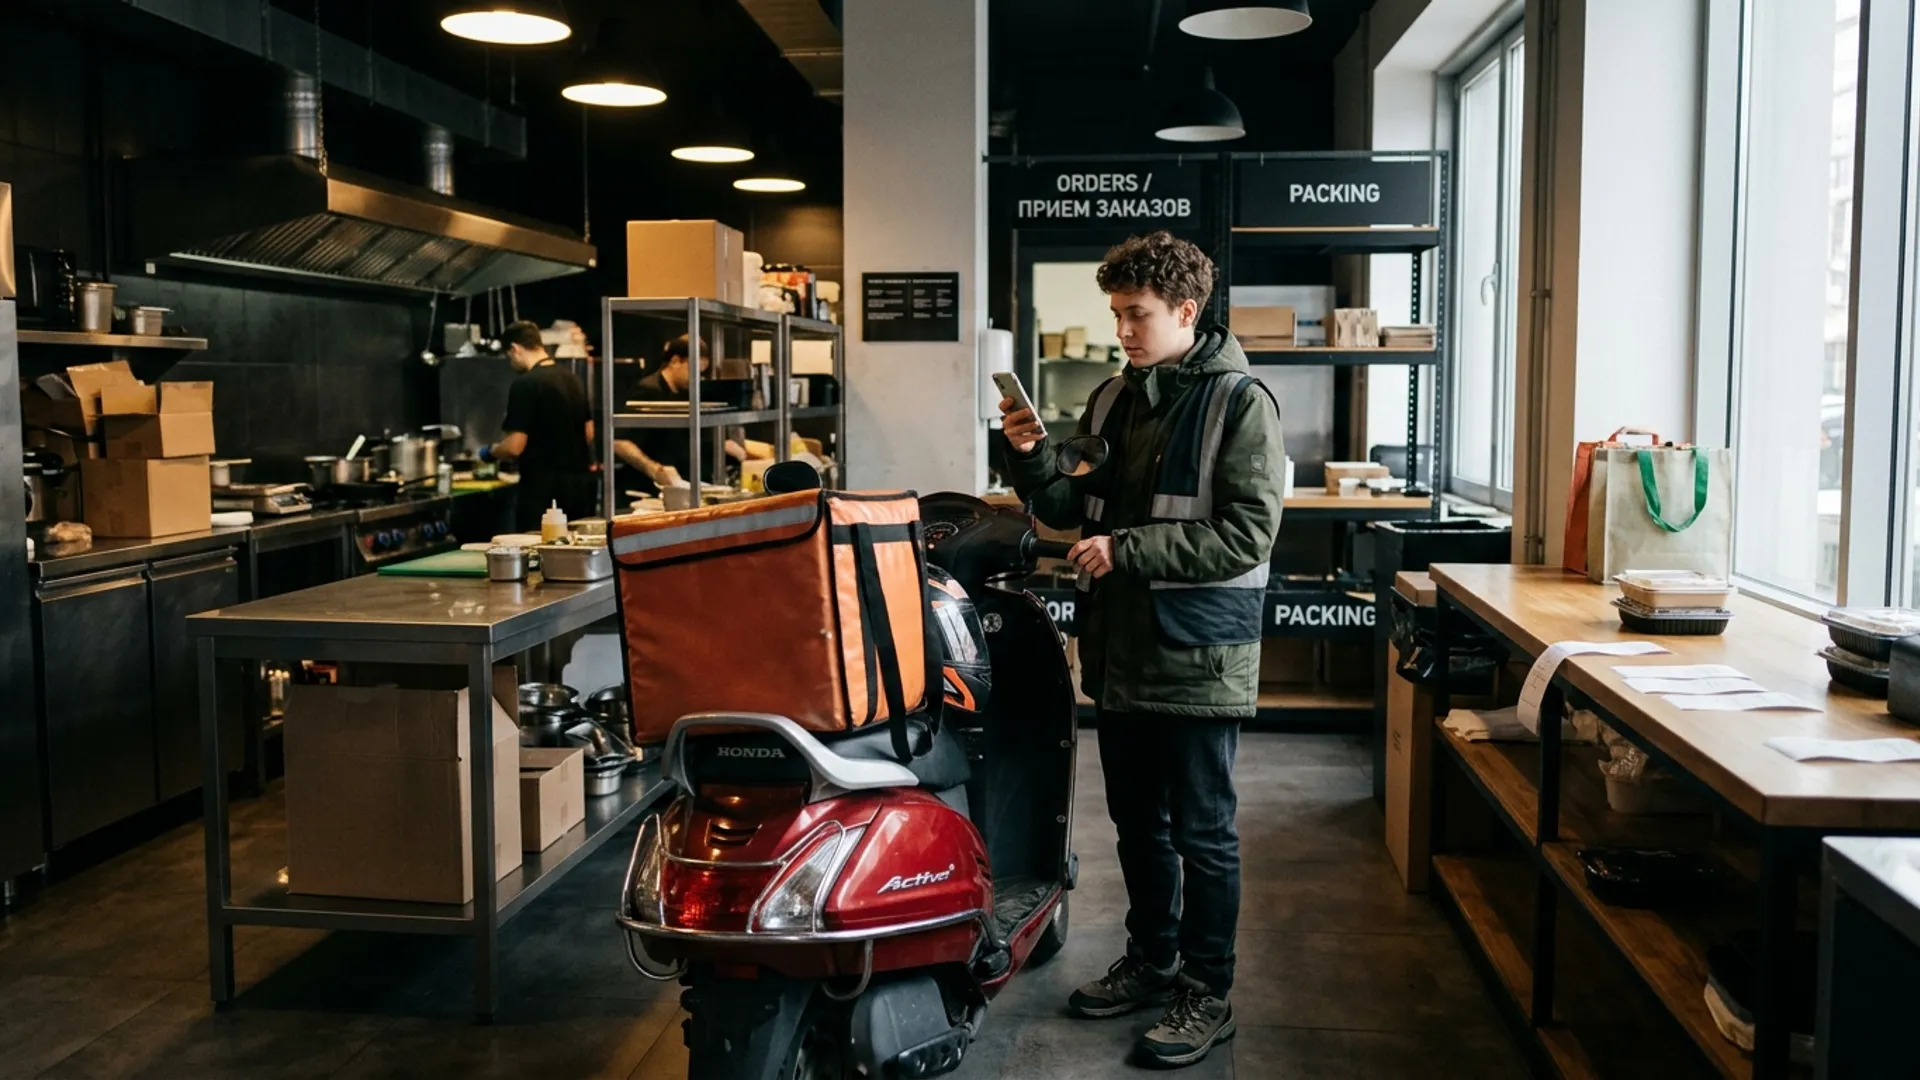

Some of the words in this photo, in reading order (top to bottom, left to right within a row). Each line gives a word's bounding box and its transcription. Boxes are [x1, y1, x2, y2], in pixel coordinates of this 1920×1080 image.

[1056, 174, 1138, 193] ORDERS
[1143, 174, 1153, 193] /
[1289, 183, 1381, 204] PACKING
[1018, 200, 1090, 218] ПРИЕМ
[1096, 199, 1192, 218] ЗАКАЗОВ
[1275, 604, 1377, 627] PACKING
[717, 746, 786, 759] HONDA
